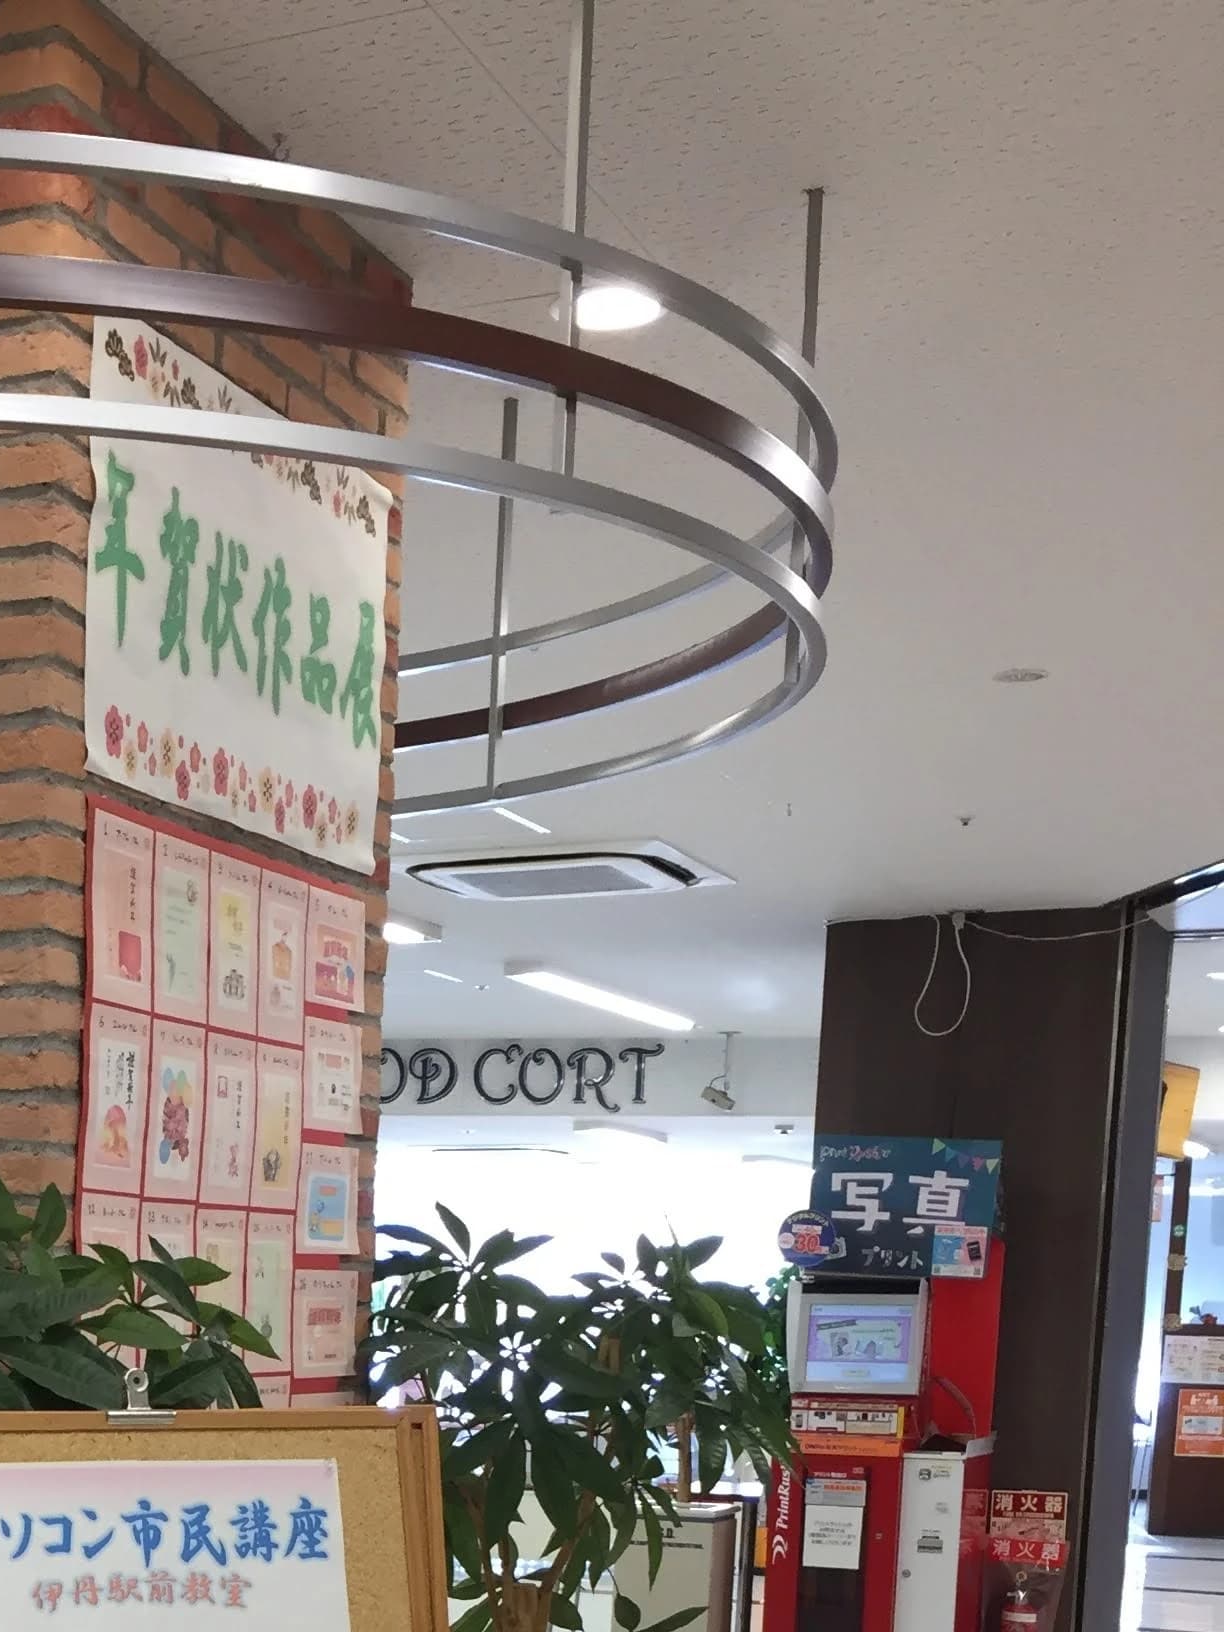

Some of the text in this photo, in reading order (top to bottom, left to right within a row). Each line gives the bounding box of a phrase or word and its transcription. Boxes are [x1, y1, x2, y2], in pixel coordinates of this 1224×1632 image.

[94, 448, 378, 749] 年賀状作品展
[473, 1043, 666, 1113] CORT
[831, 1170, 970, 1233] 写真
[861, 1245, 924, 1270] プリント
[776, 1464, 791, 1529] PrintRus
[995, 1493, 1063, 1513] 消火器
[31, 1569, 254, 1612] 伊丹駅前教室
